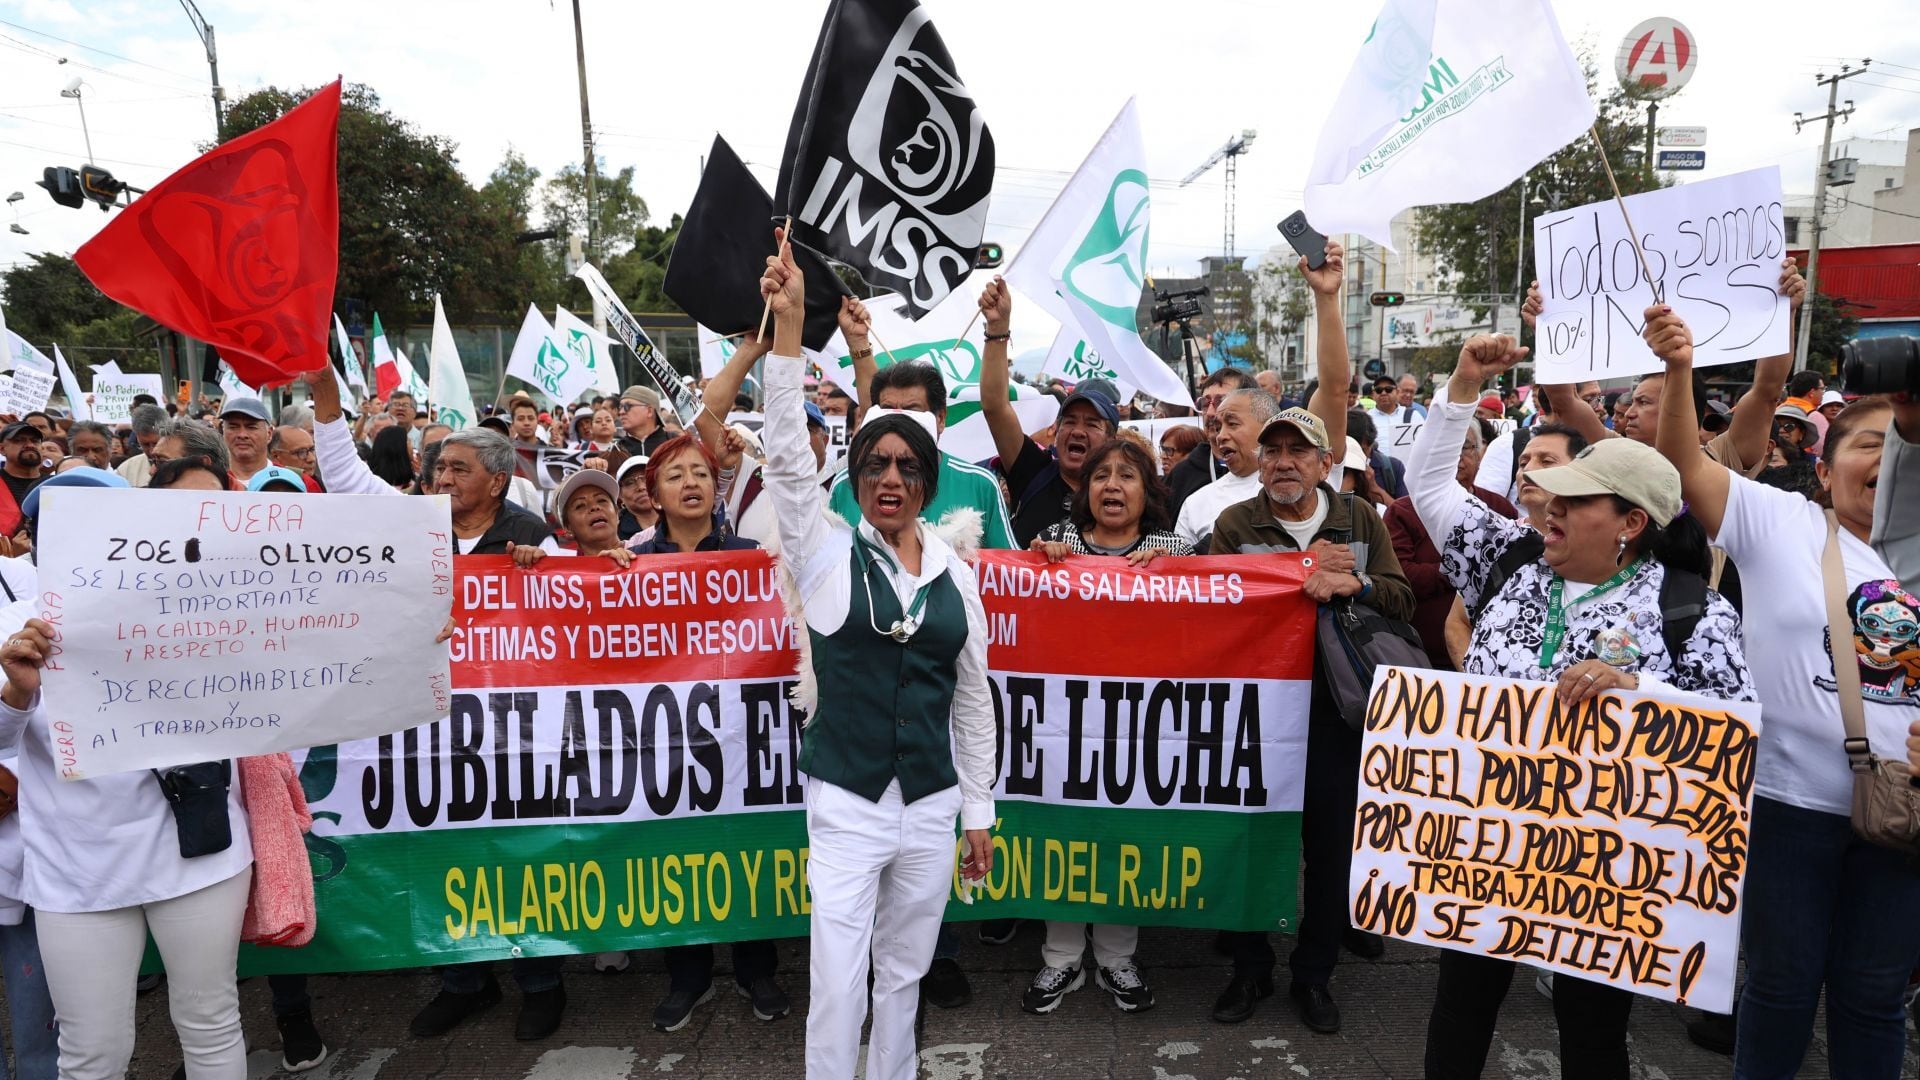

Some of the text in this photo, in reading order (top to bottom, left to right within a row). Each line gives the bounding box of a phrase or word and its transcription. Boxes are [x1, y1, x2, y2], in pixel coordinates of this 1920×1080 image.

[798, 155, 970, 311] IMSS
[1540, 211, 1667, 300] Todos
[1547, 317, 1586, 355] 10%
[1589, 263, 1779, 371] IMSS
[97, 381, 112, 393] No
[198, 501, 303, 534] FUERA
[107, 537, 396, 566] ZOE OLIVOS R
[428, 531, 451, 596] FUERA
[70, 567, 103, 588] SE
[291, 568, 322, 584] LO
[336, 569, 388, 584] MAS
[155, 587, 320, 615] IMPORTANTE
[463, 575, 517, 610] DEL
[523, 574, 593, 615] IMSS,
[600, 570, 697, 608] EXIGEN
[705, 567, 783, 605] SOLU
[1078, 571, 1244, 604] SALARIALES
[118, 622, 147, 641] LA
[265, 612, 360, 633] HUMANID
[144, 639, 245, 661] RESPETO
[563, 625, 581, 659] Y
[588, 622, 678, 659] DEBEN
[428, 672, 449, 711] FUERA
[1457, 683, 1545, 746] HAY
[1542, 693, 1623, 756] MAS
[53, 720, 79, 779] FUERA
[361, 681, 724, 829] JUBILADOS
[1062, 679, 1268, 807] LUCHA
[1477, 748, 1583, 820] PODER
[1675, 779, 1747, 872] IMSS
[1356, 801, 1740, 914] POR QUE EL PODER DE LOS
[444, 859, 607, 940] SALARIO
[617, 851, 733, 928] JUSTO
[740, 850, 764, 918] Y
[1044, 838, 1108, 905] DEL
[1118, 843, 1205, 910] R.J.P.
[1408, 861, 1664, 938] TRABAJADORES
[1424, 902, 1484, 944] SE
